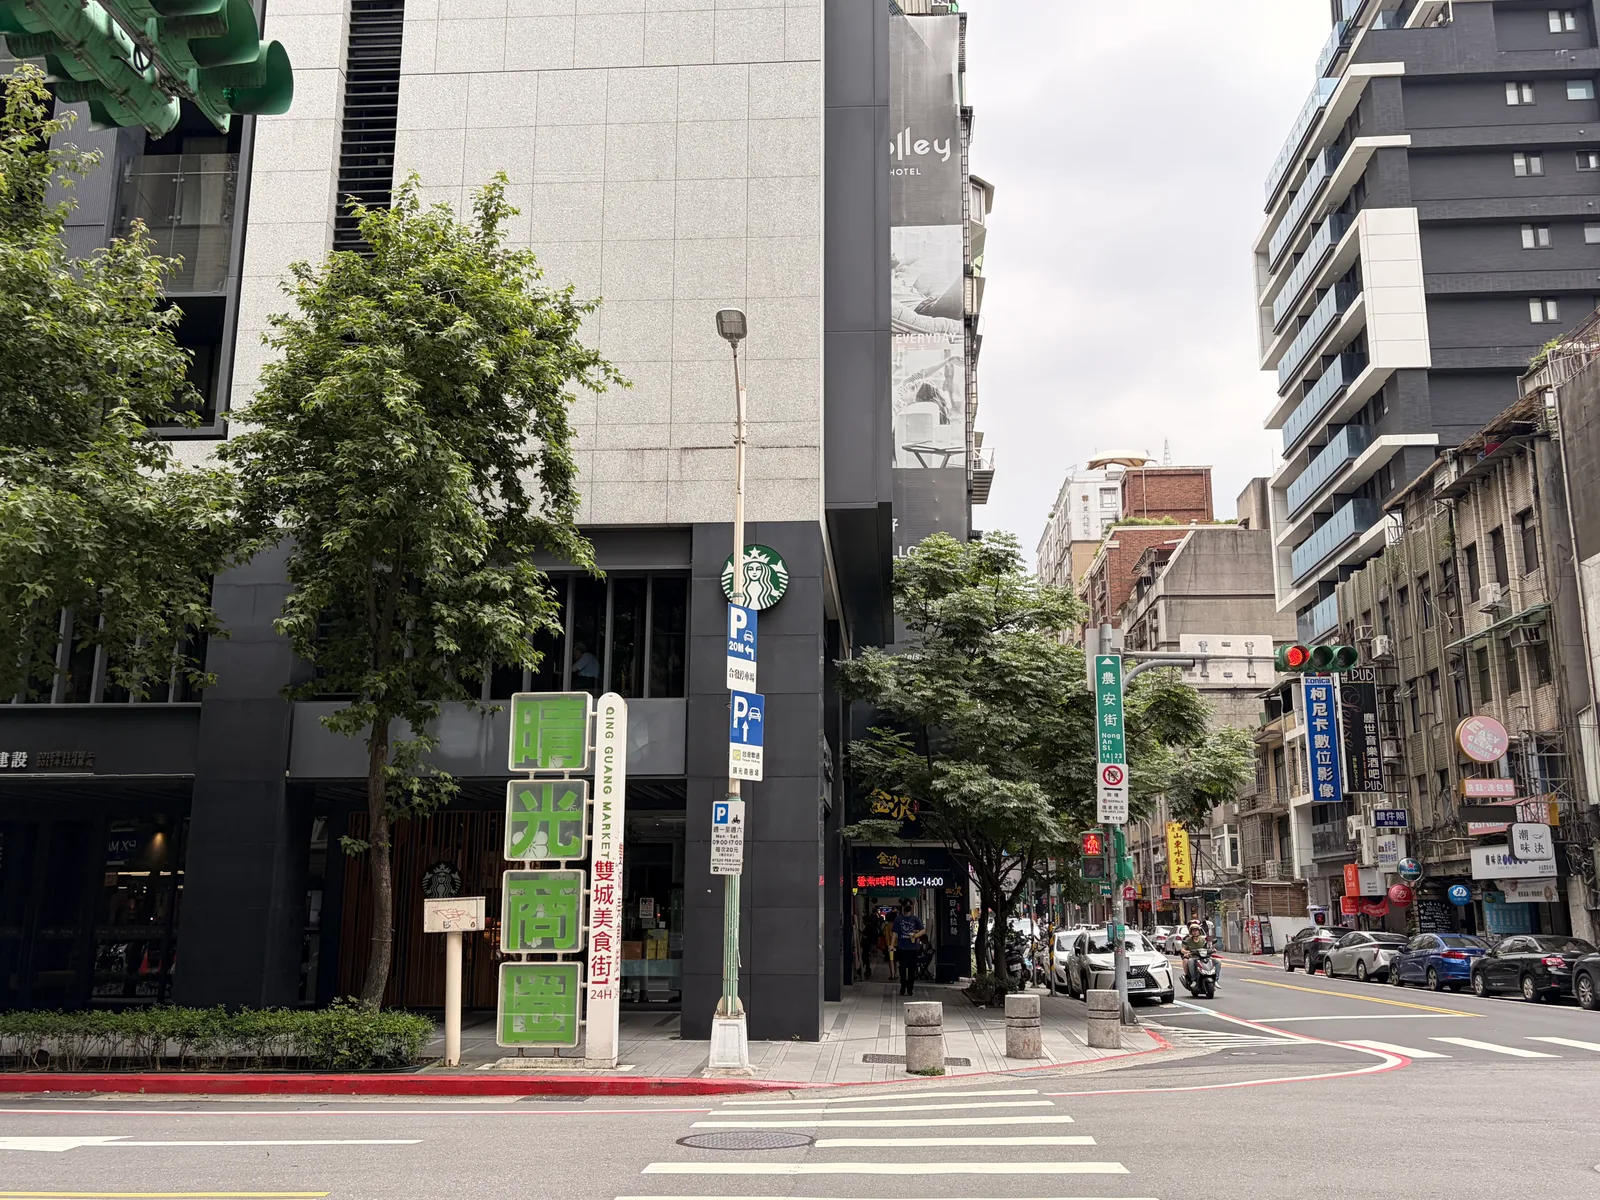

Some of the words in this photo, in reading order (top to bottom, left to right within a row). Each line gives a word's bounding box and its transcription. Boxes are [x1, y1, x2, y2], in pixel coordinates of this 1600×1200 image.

[895, 333, 957, 344] EVERYDAY
[730, 606, 747, 639] P
[728, 640, 744, 653] 20M
[1304, 677, 1331, 685] Konica
[1351, 669, 1374, 681] PUB
[733, 695, 749, 729] P
[1101, 671, 1118, 727] 農安街
[605, 706, 615, 739] QING
[1310, 687, 1335, 798] 柯尼卡數位影像
[1467, 735, 1502, 756] CLEAN
[602, 746, 614, 795] GUANG
[1364, 780, 1383, 791] PUB
[716, 806, 727, 821] P
[600, 801, 612, 860] MARKET
[1518, 829, 1529, 841] 潮
[1173, 832, 1186, 883] 山東水餃大王
[504, 698, 587, 1045] 晴光商圈
[896, 877, 944, 887] 11:30~14:00
[591, 860, 615, 977] 雙城美食街
[590, 990, 612, 1000] 24H
